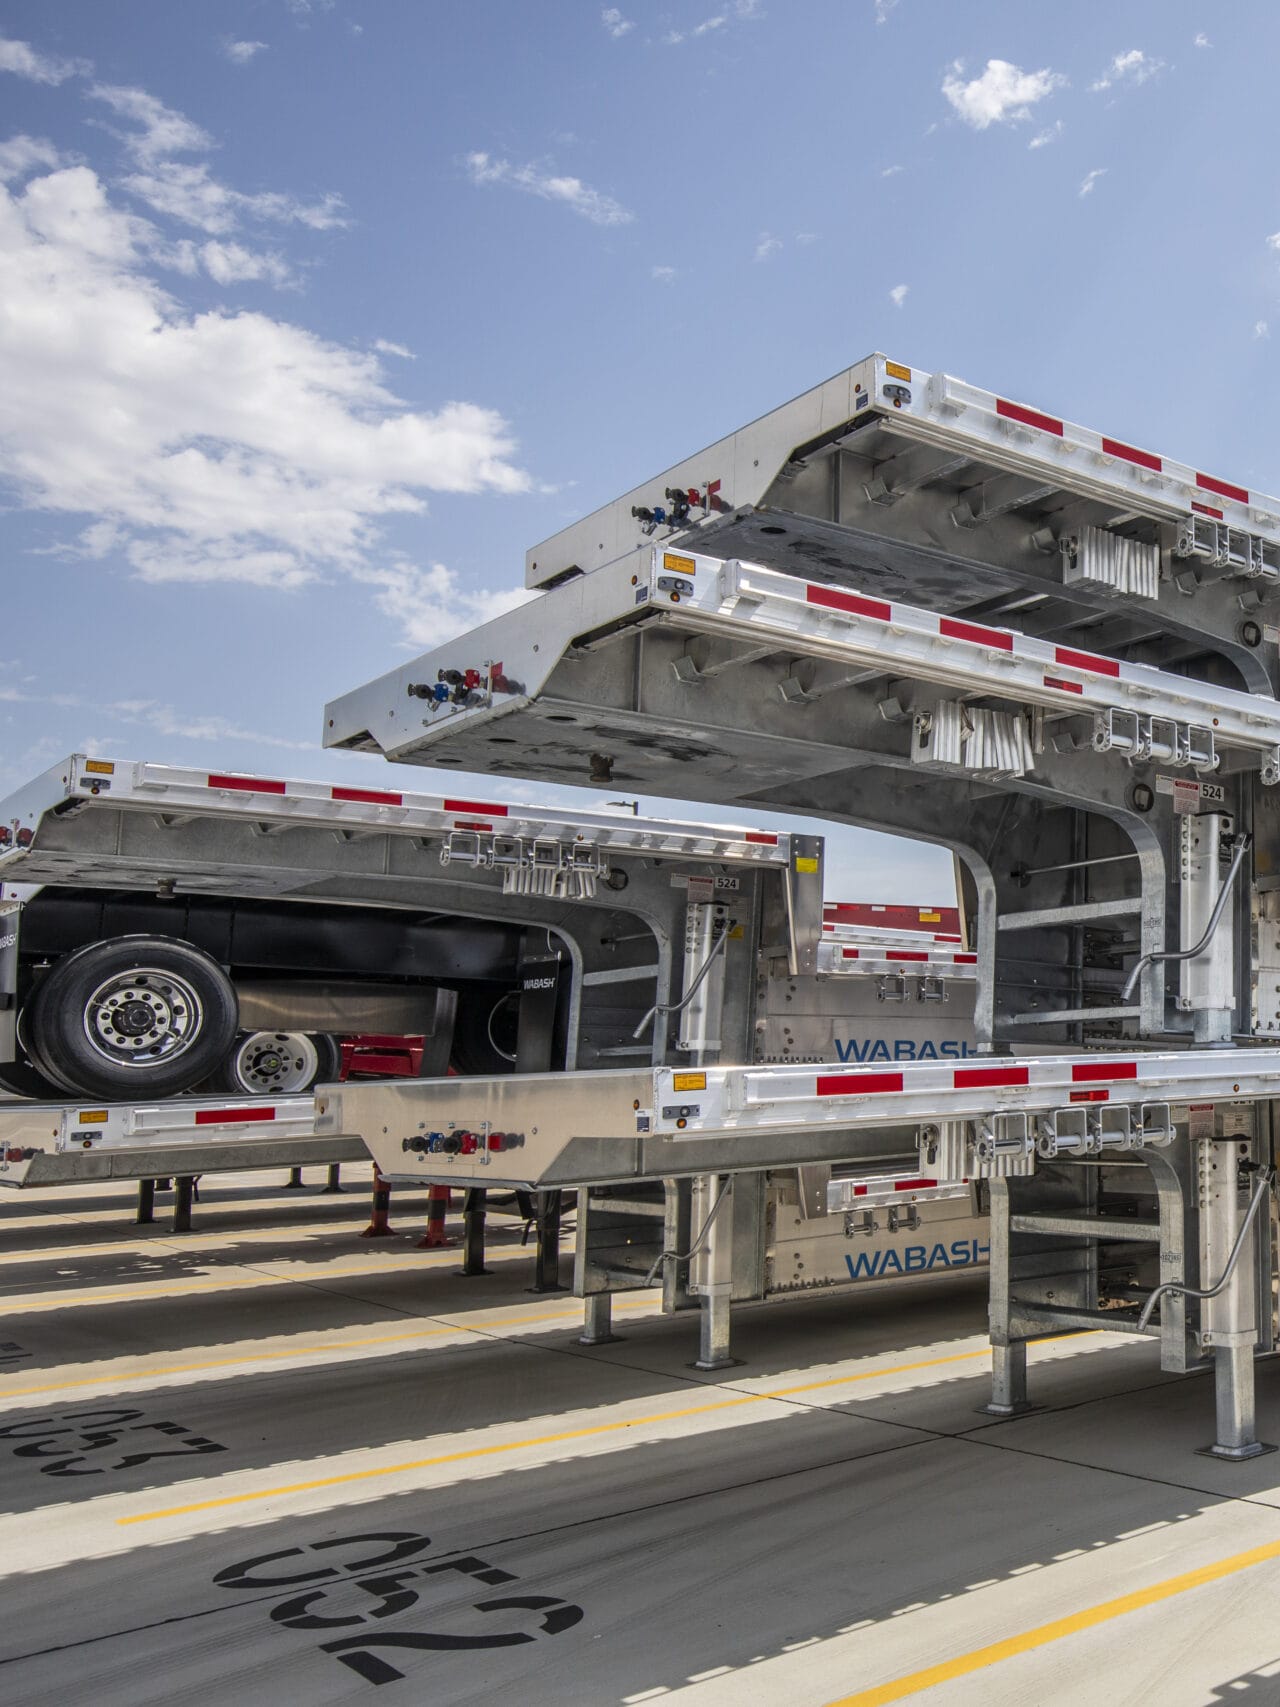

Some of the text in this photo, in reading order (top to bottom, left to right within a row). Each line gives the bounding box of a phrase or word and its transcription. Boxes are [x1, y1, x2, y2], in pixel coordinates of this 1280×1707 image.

[1202, 785, 1221, 799] 524
[717, 878, 736, 888] 524
[212, 1532, 584, 1685] 052
